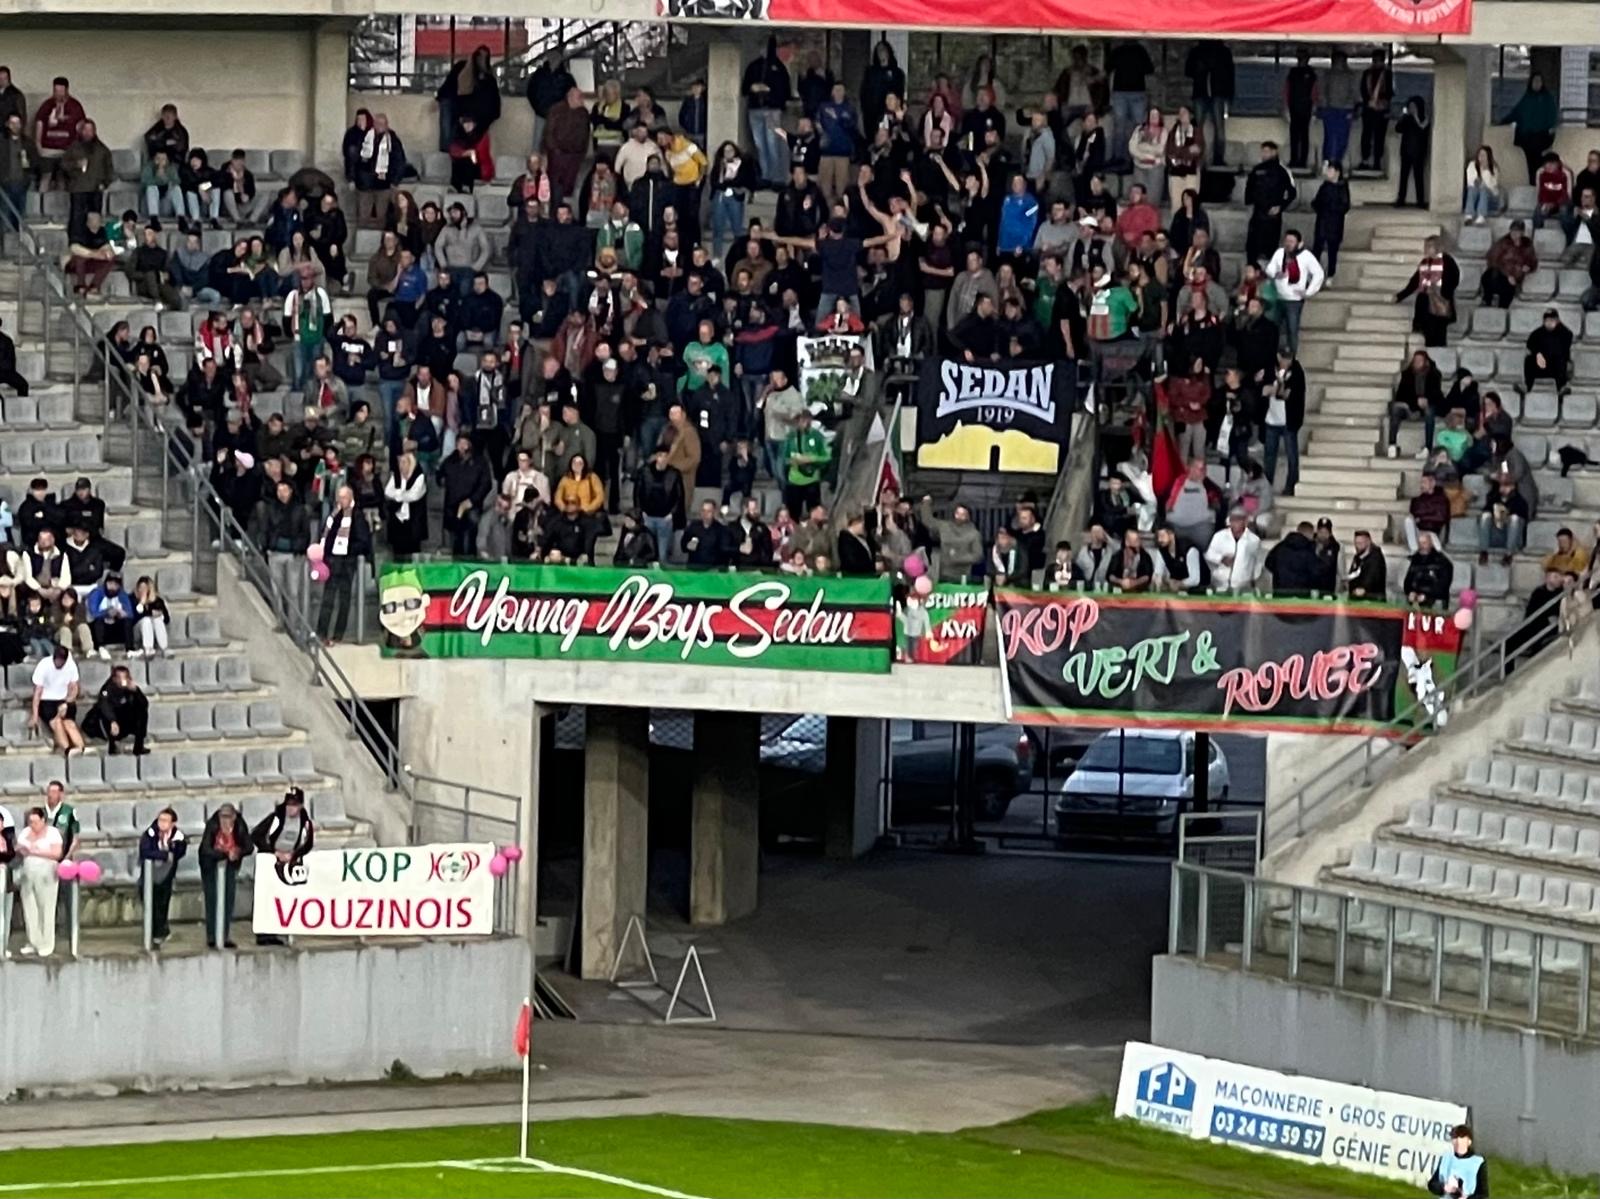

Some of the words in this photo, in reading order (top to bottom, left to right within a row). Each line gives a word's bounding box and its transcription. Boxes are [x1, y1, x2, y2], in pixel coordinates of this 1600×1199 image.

[940, 359, 1055, 411] SEDAN
[977, 406, 1015, 422] 1919
[450, 570, 589, 652] Young
[596, 575, 723, 660] Boys
[727, 581, 855, 658] Sedan
[1002, 597, 1099, 660] KOP
[1062, 629, 1190, 699] VERT
[1191, 630, 1221, 675] &
[1217, 642, 1382, 720] ROUGE
[341, 851, 412, 883] KOP
[274, 897, 473, 929] VOUZINOIS
[1215, 1079, 1324, 1118] MAÇONNERIE
[1339, 1103, 1386, 1130] GROS
[1215, 1111, 1235, 1134] 03
[1237, 1115, 1256, 1137] 24
[1259, 1120, 1277, 1142] 55
[1280, 1124, 1300, 1146] 59
[1303, 1128, 1322, 1151] 57
[1332, 1131, 1391, 1167] GÉNIE
